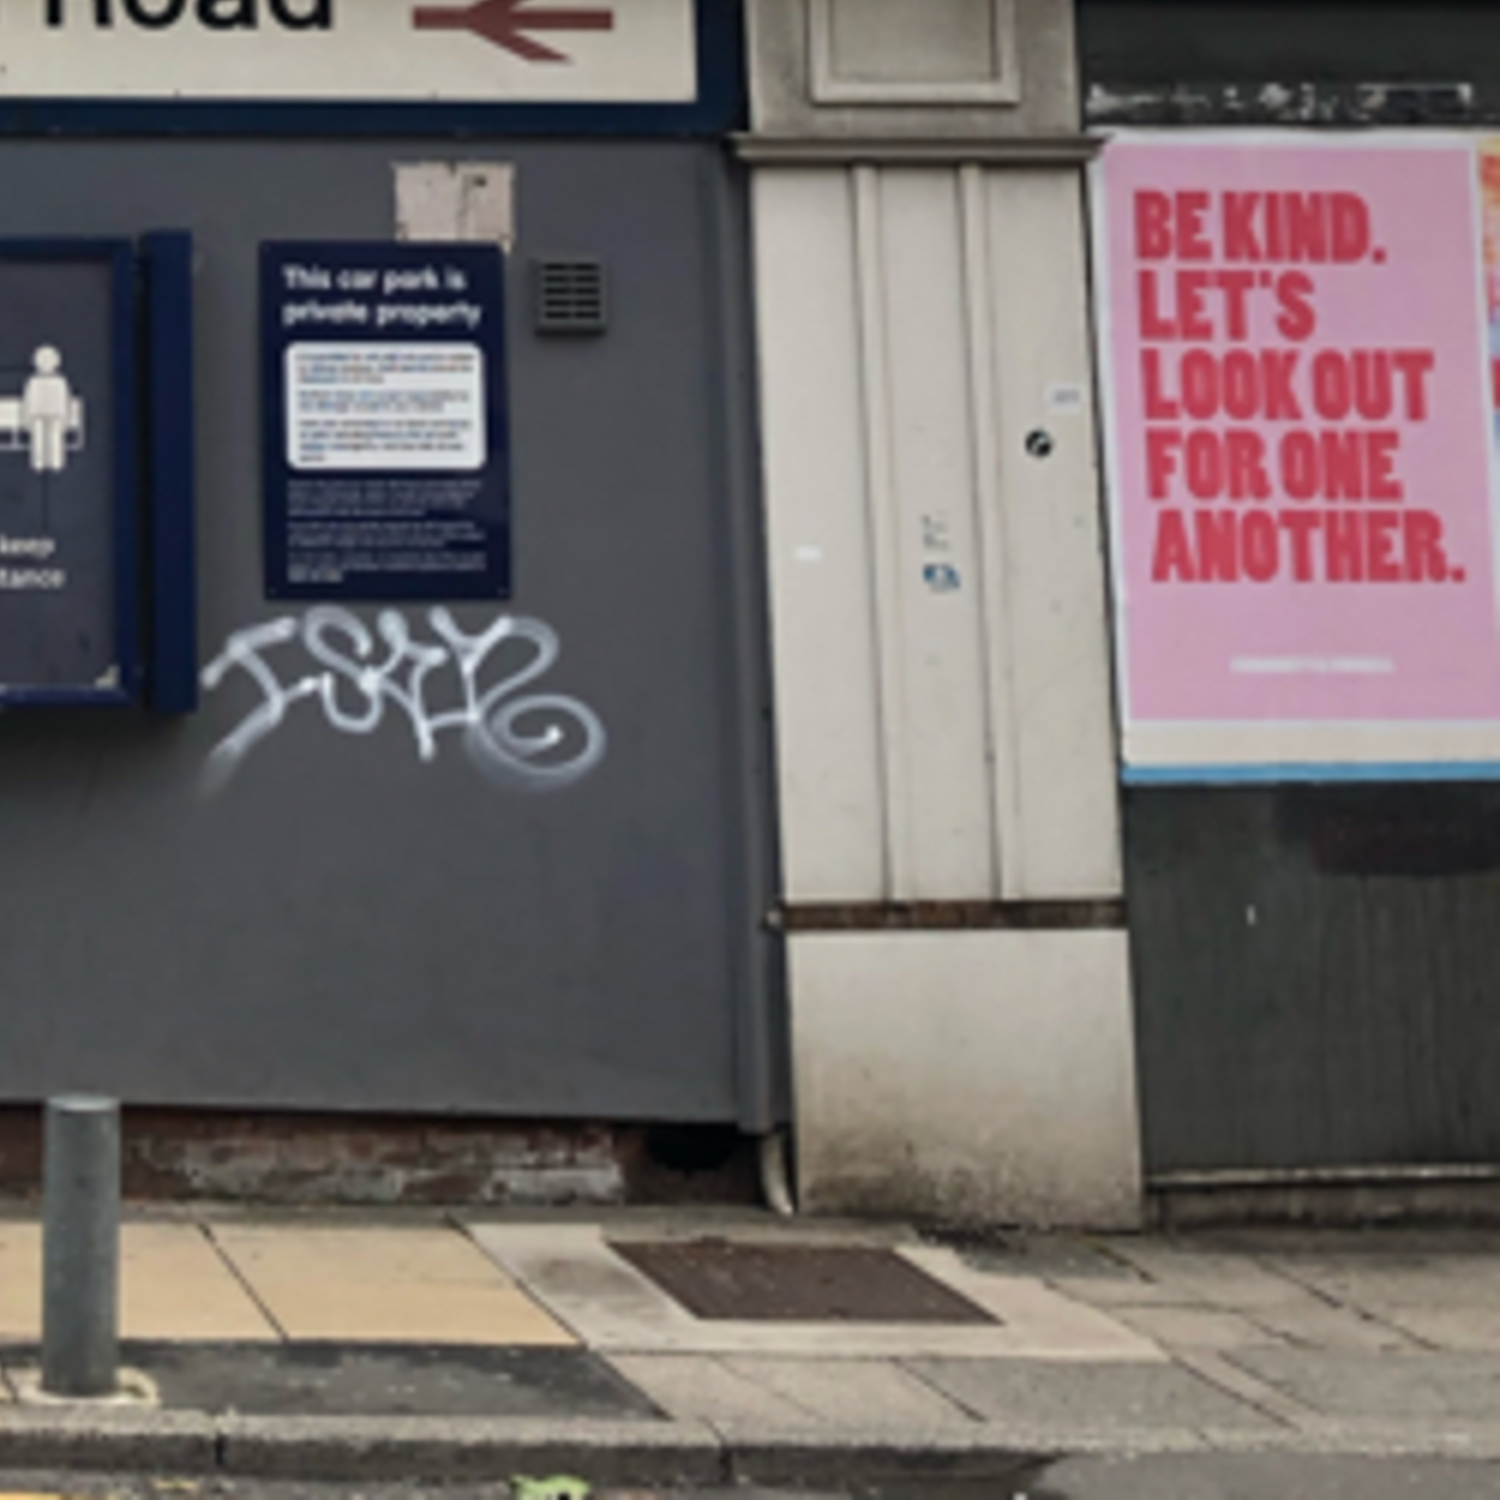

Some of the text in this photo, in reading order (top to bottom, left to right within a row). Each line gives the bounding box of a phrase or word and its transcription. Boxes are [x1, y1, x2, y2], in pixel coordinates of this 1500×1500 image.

[1134, 190, 1386, 266] BE KIND.
[281, 302, 483, 329] private property
[282, 263, 467, 294] This car park is
[1138, 270, 1316, 342] LET'S
[1142, 348, 1435, 422] LOOK OUT
[1146, 428, 1405, 502] FOR ONE
[1150, 509, 1467, 584] ANOTHER.
